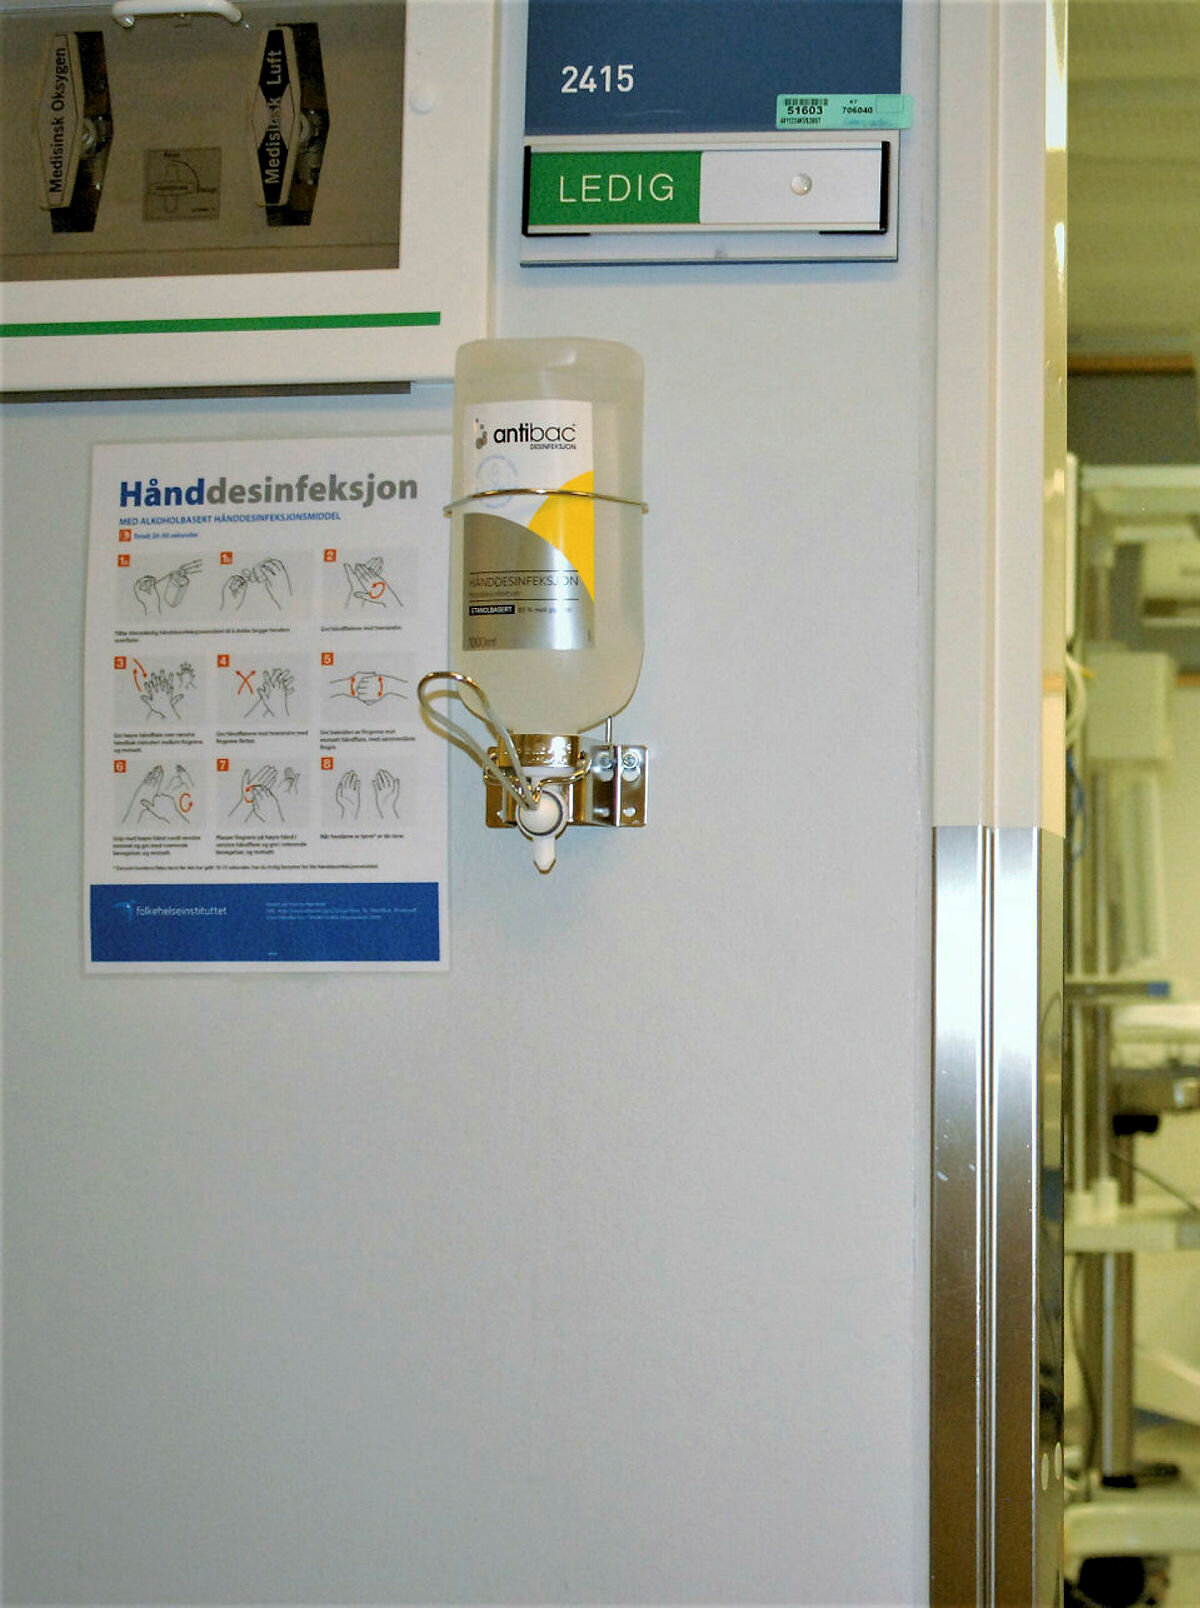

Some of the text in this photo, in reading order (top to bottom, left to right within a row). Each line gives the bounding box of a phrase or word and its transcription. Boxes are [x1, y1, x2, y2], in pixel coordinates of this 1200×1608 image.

[266, 49, 282, 85] Luft
[561, 64, 635, 94] 2415
[787, 106, 823, 115] 51603
[49, 48, 69, 193] Medisinsk Oksygen
[559, 173, 674, 203] LEDIG
[493, 422, 576, 444] antibac
[119, 473, 418, 508] Hånddesinfeksjon
[119, 510, 341, 526] MED ALKOHOLBASERT HÅNDDESINFEKSJONSMIDDEL
[326, 550, 334, 561] 2
[116, 658, 125, 668] 3
[219, 656, 227, 666] 4
[324, 654, 332, 664] 5
[116, 762, 124, 772] 6
[219, 760, 227, 770] 7
[323, 759, 331, 769] 8
[136, 906, 228, 917] folkehelseinstituttet
